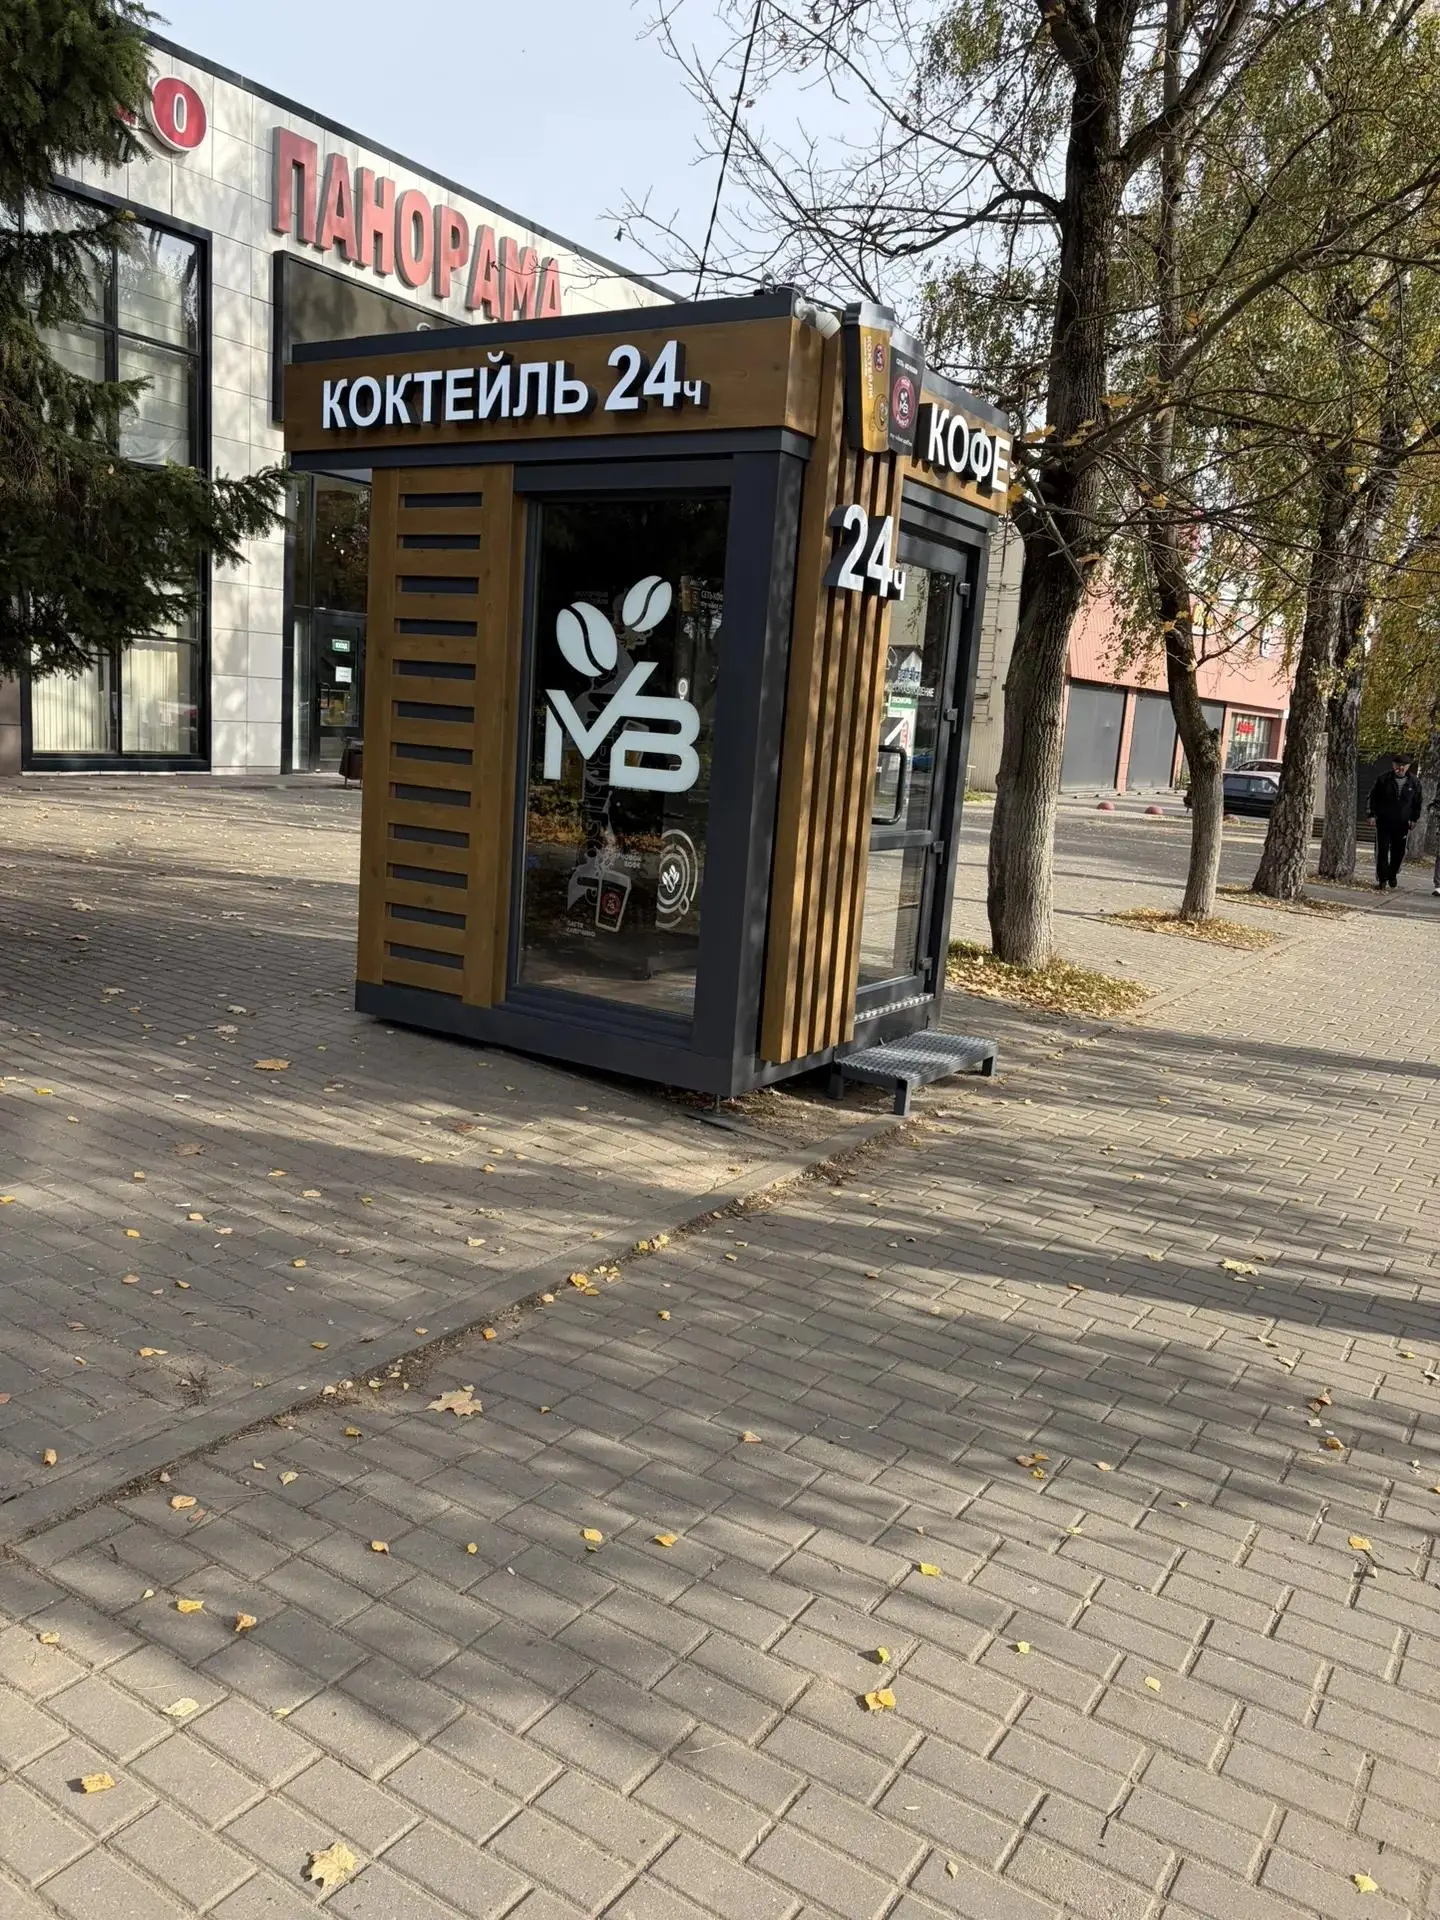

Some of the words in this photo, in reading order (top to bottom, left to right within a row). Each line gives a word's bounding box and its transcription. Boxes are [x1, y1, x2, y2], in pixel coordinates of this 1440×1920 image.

[273, 126, 563, 320] ПАНОРАМА
[322, 351, 590, 430] КОКТЕЙЛЬ
[604, 340, 703, 411] 24ч
[928, 403, 1011, 494] КОФЕ
